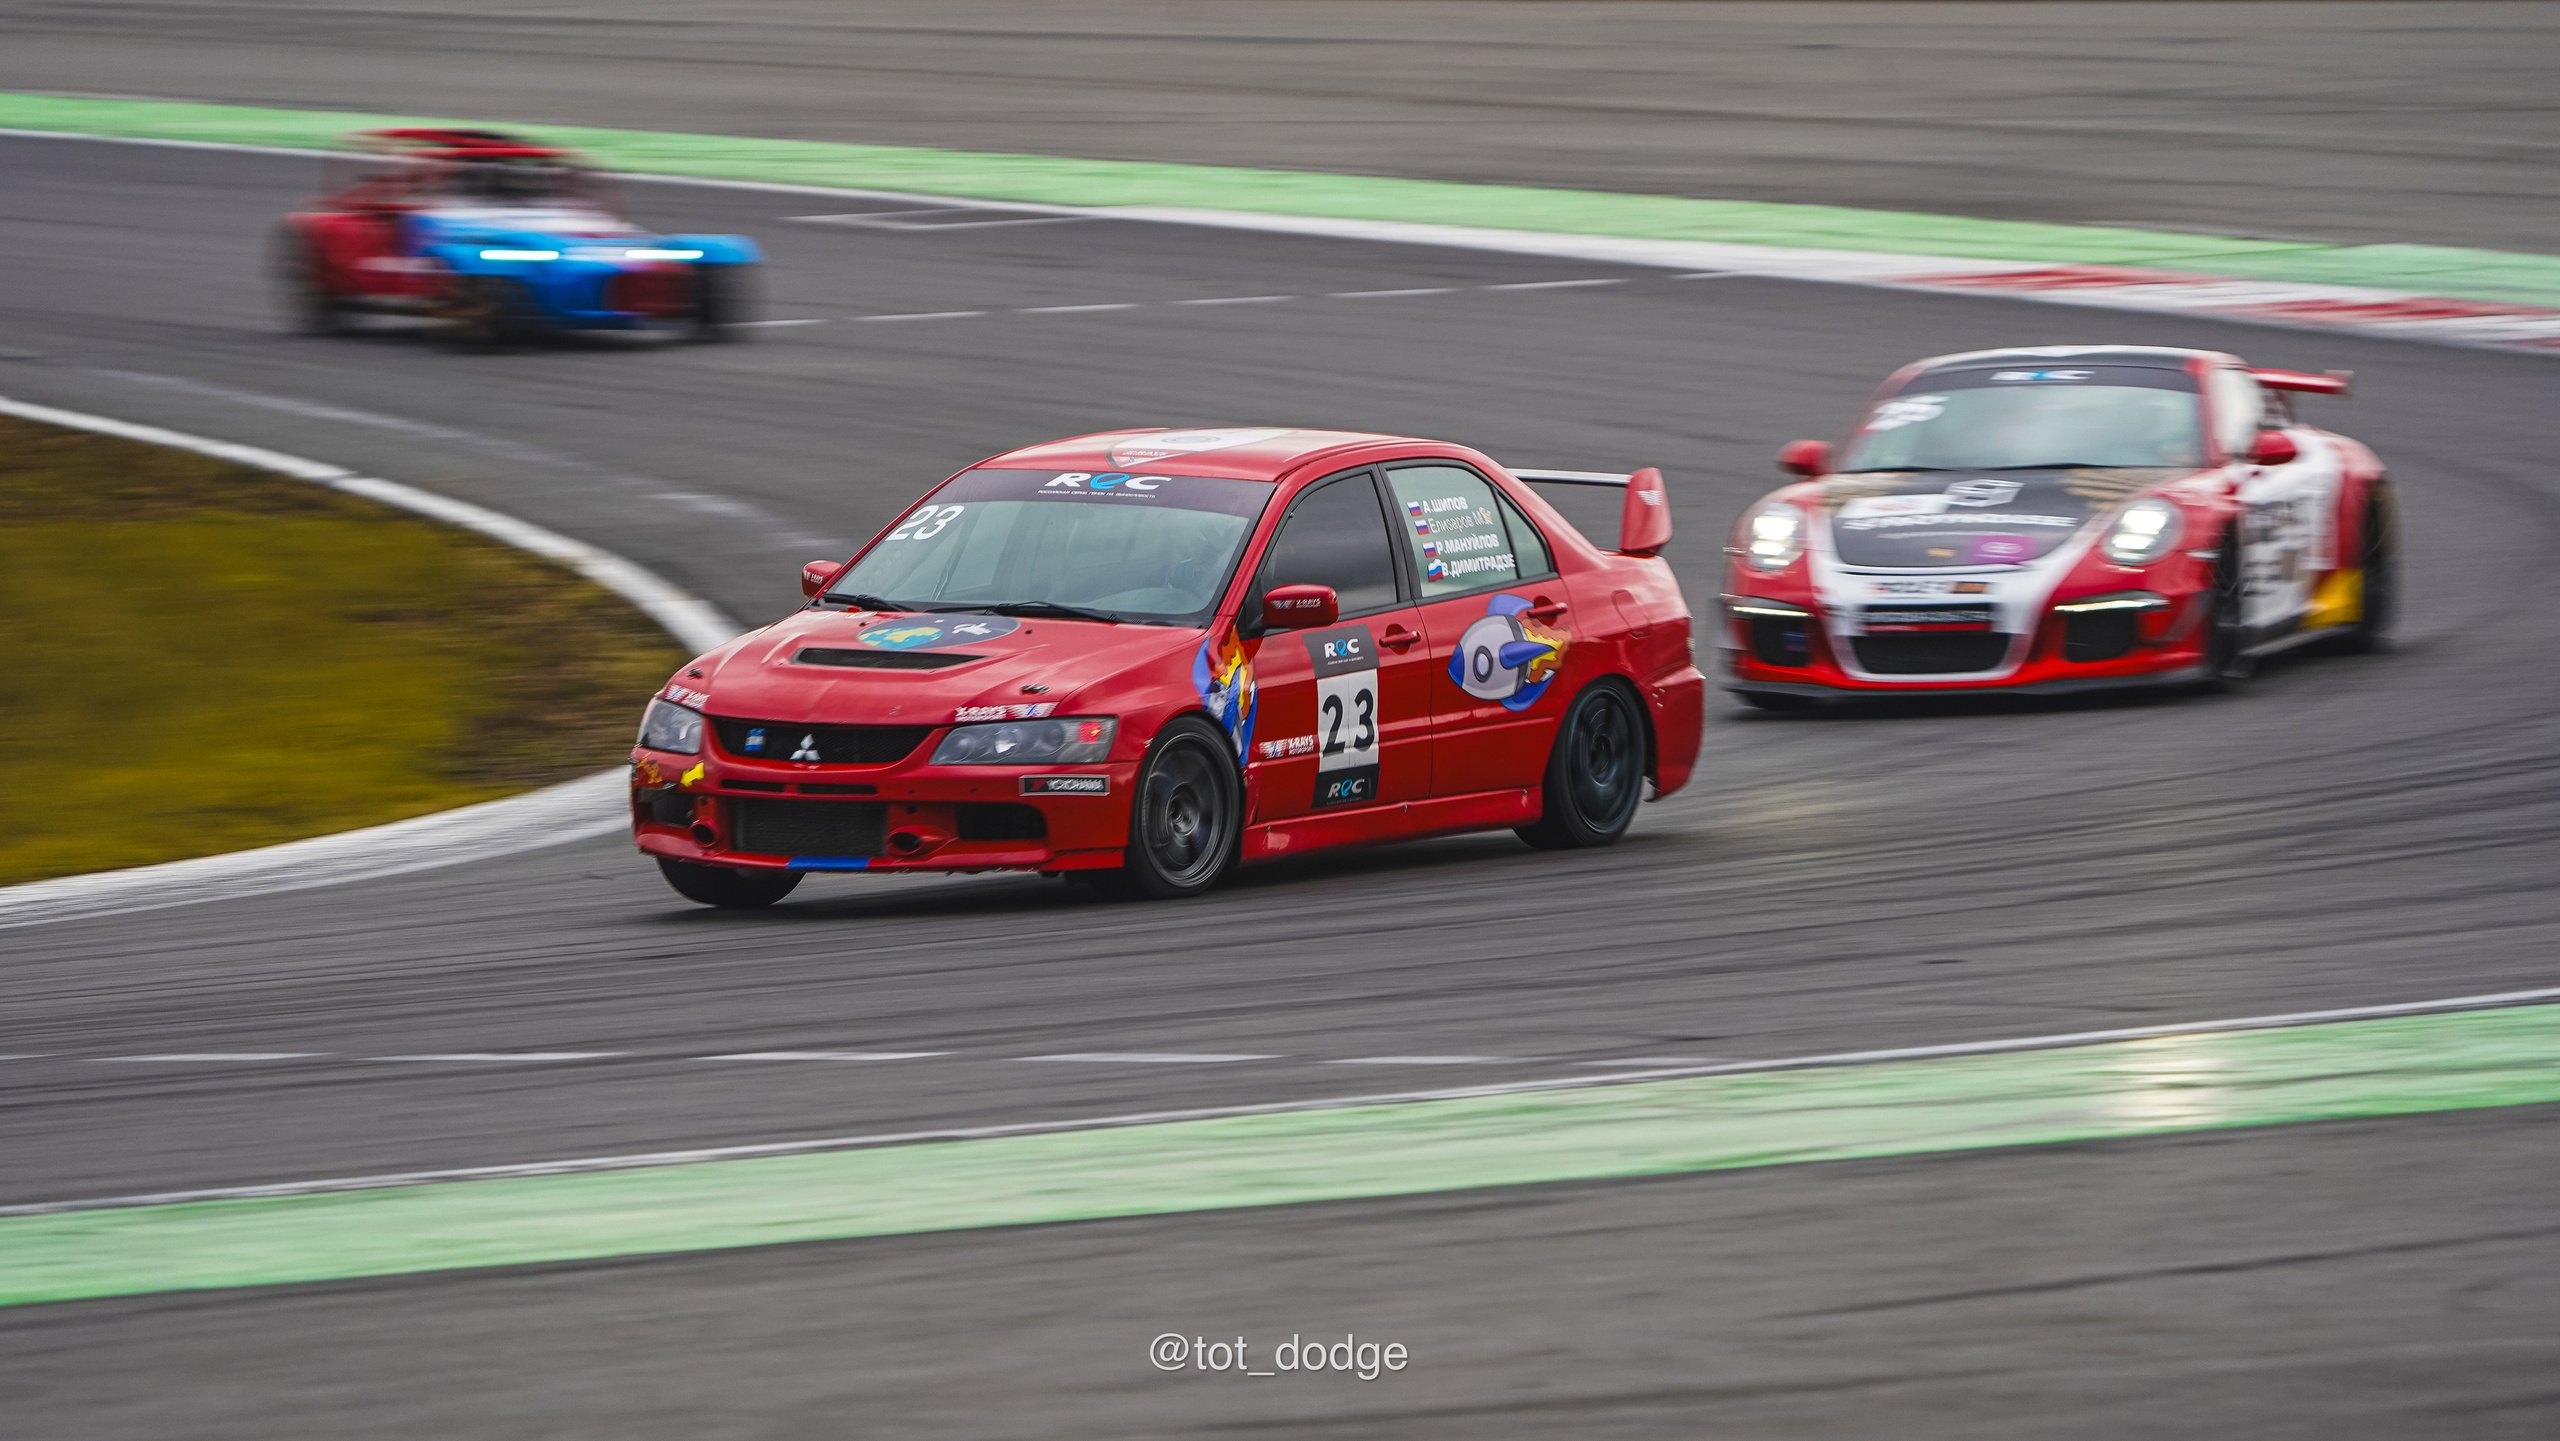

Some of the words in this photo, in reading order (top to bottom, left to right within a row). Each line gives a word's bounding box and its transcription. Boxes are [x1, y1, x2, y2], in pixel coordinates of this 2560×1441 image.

[1422, 496, 1468, 514] А.ШИПОВ
[885, 505, 965, 541] 23
[1428, 515, 1474, 534] Елизаров
[1435, 533, 1500, 555] Р.МАНУЙЛОВ
[1441, 553, 1516, 577] В.ДИМИТРАДЗЕ
[1322, 688, 1375, 757] 23
[1288, 734, 1314, 749] X-RAYS
